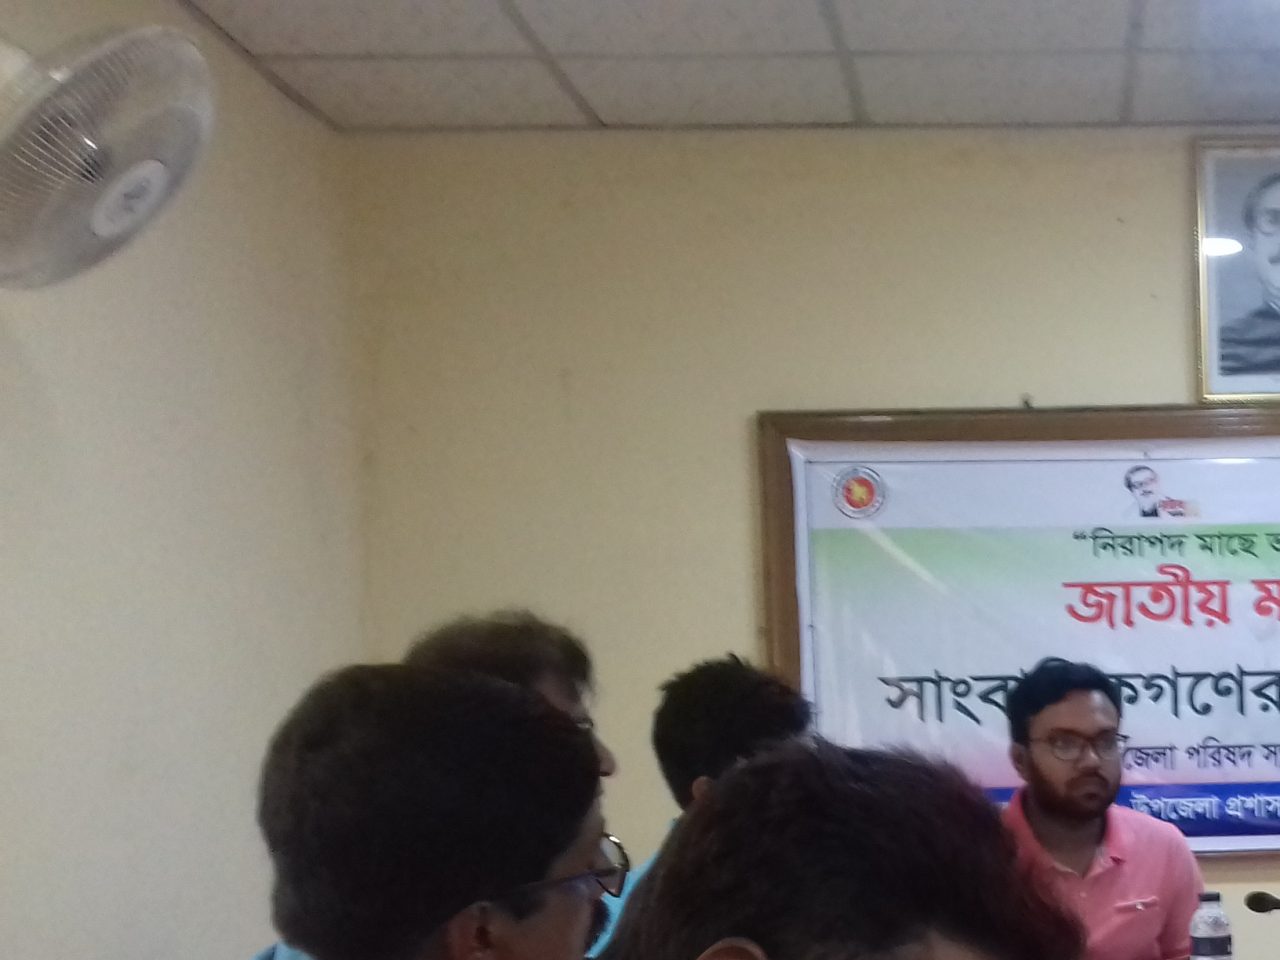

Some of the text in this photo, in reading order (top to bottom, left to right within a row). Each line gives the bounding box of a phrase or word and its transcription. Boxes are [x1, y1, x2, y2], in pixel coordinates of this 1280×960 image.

[1194, 532, 1259, 558] মাছে
[1062, 564, 1232, 629] জাতীয়
[1187, 736, 1255, 769] পরিষদ
[1129, 791, 1220, 820] উপজেলা
